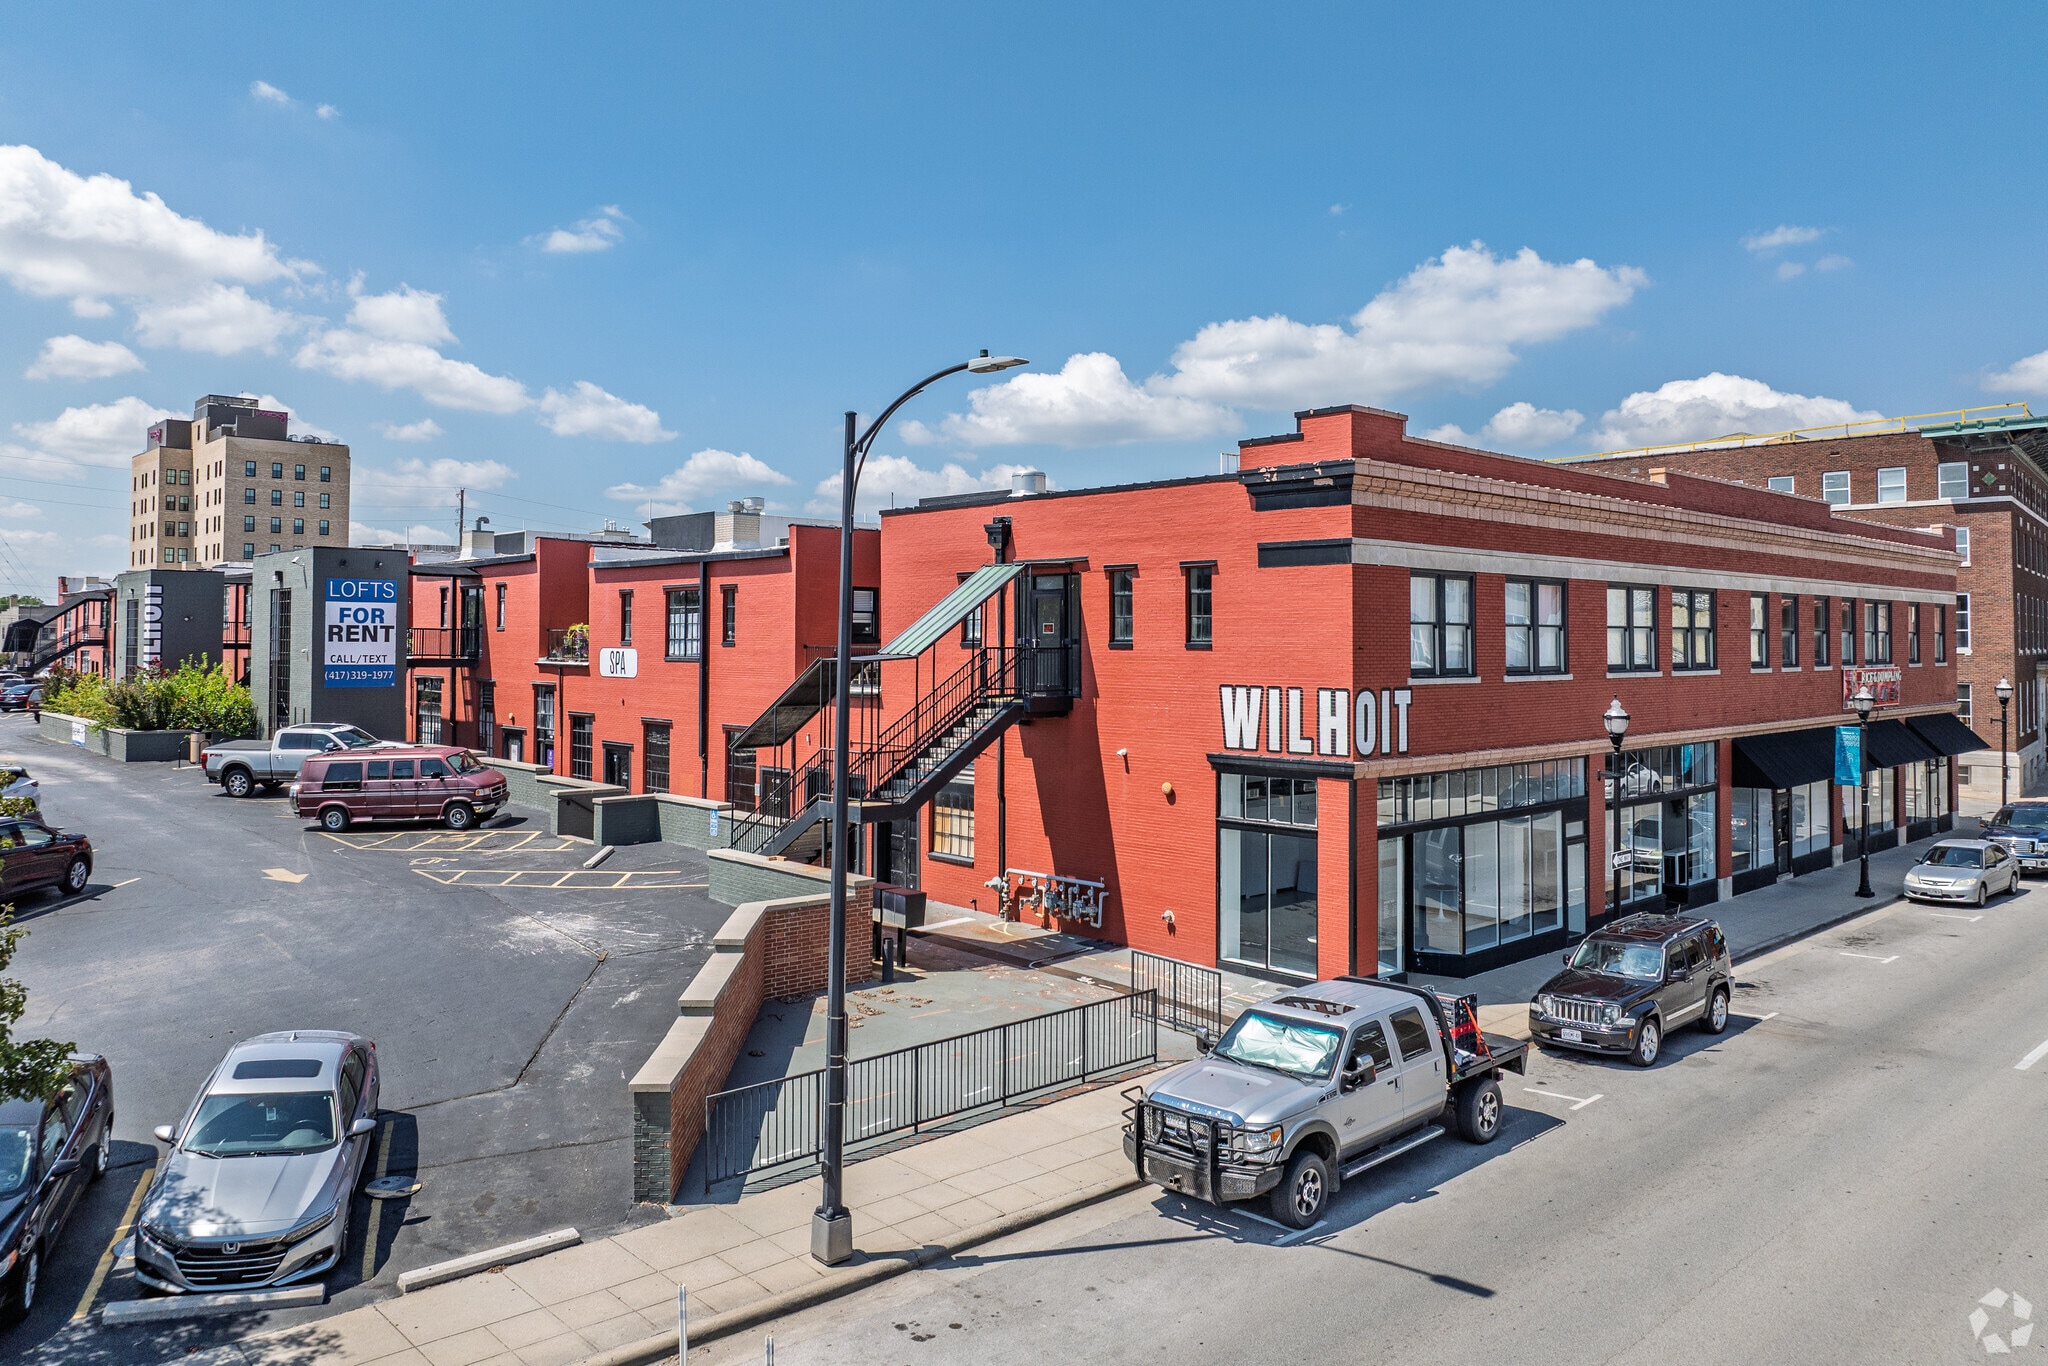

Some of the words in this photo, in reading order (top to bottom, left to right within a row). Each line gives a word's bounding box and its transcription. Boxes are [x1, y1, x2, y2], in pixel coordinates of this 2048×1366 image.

[329, 581, 395, 599] LOFTS
[339, 607, 385, 624] FOR
[143, 582, 163, 685] ILHOIT
[328, 624, 395, 643] RENT
[330, 654, 388, 664] CALL/TEXT
[609, 650, 626, 675] SPA
[324, 670, 394, 681] (417)319-1977
[1219, 684, 1412, 758] WILHOIT
